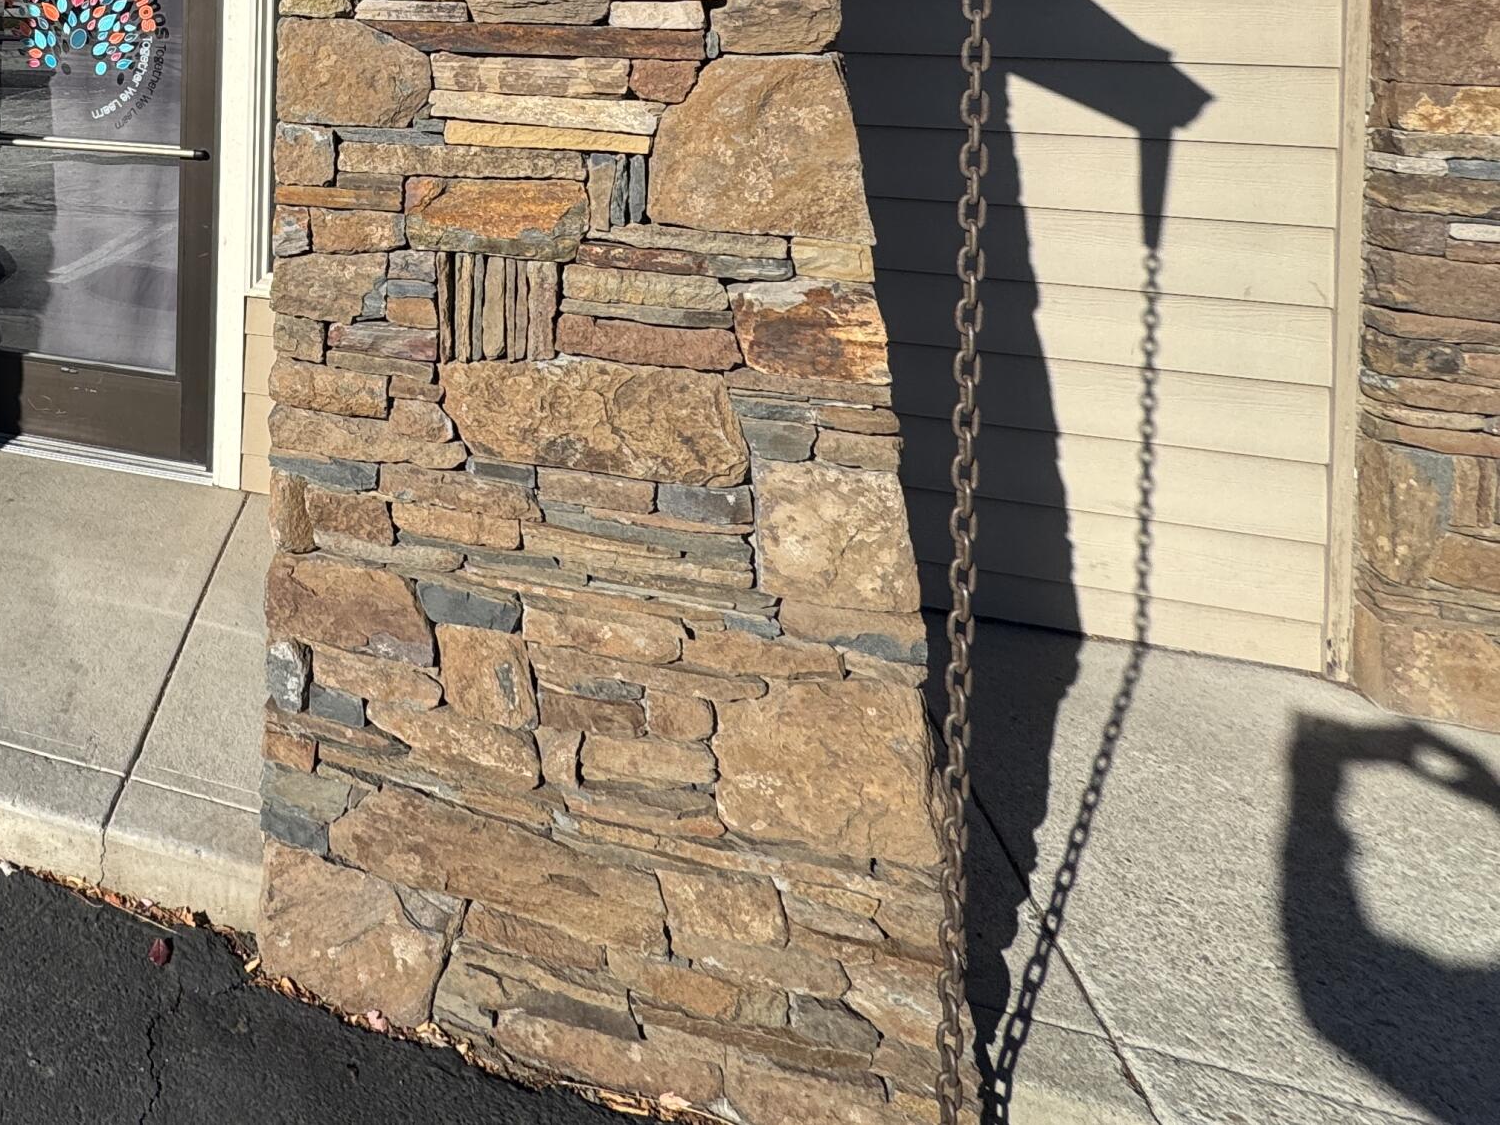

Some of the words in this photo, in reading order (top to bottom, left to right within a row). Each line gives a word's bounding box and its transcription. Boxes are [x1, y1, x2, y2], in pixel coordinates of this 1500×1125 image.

[131, 36, 153, 88] Together
[119, 86, 138, 102] We
[91, 98, 123, 120] Learn
